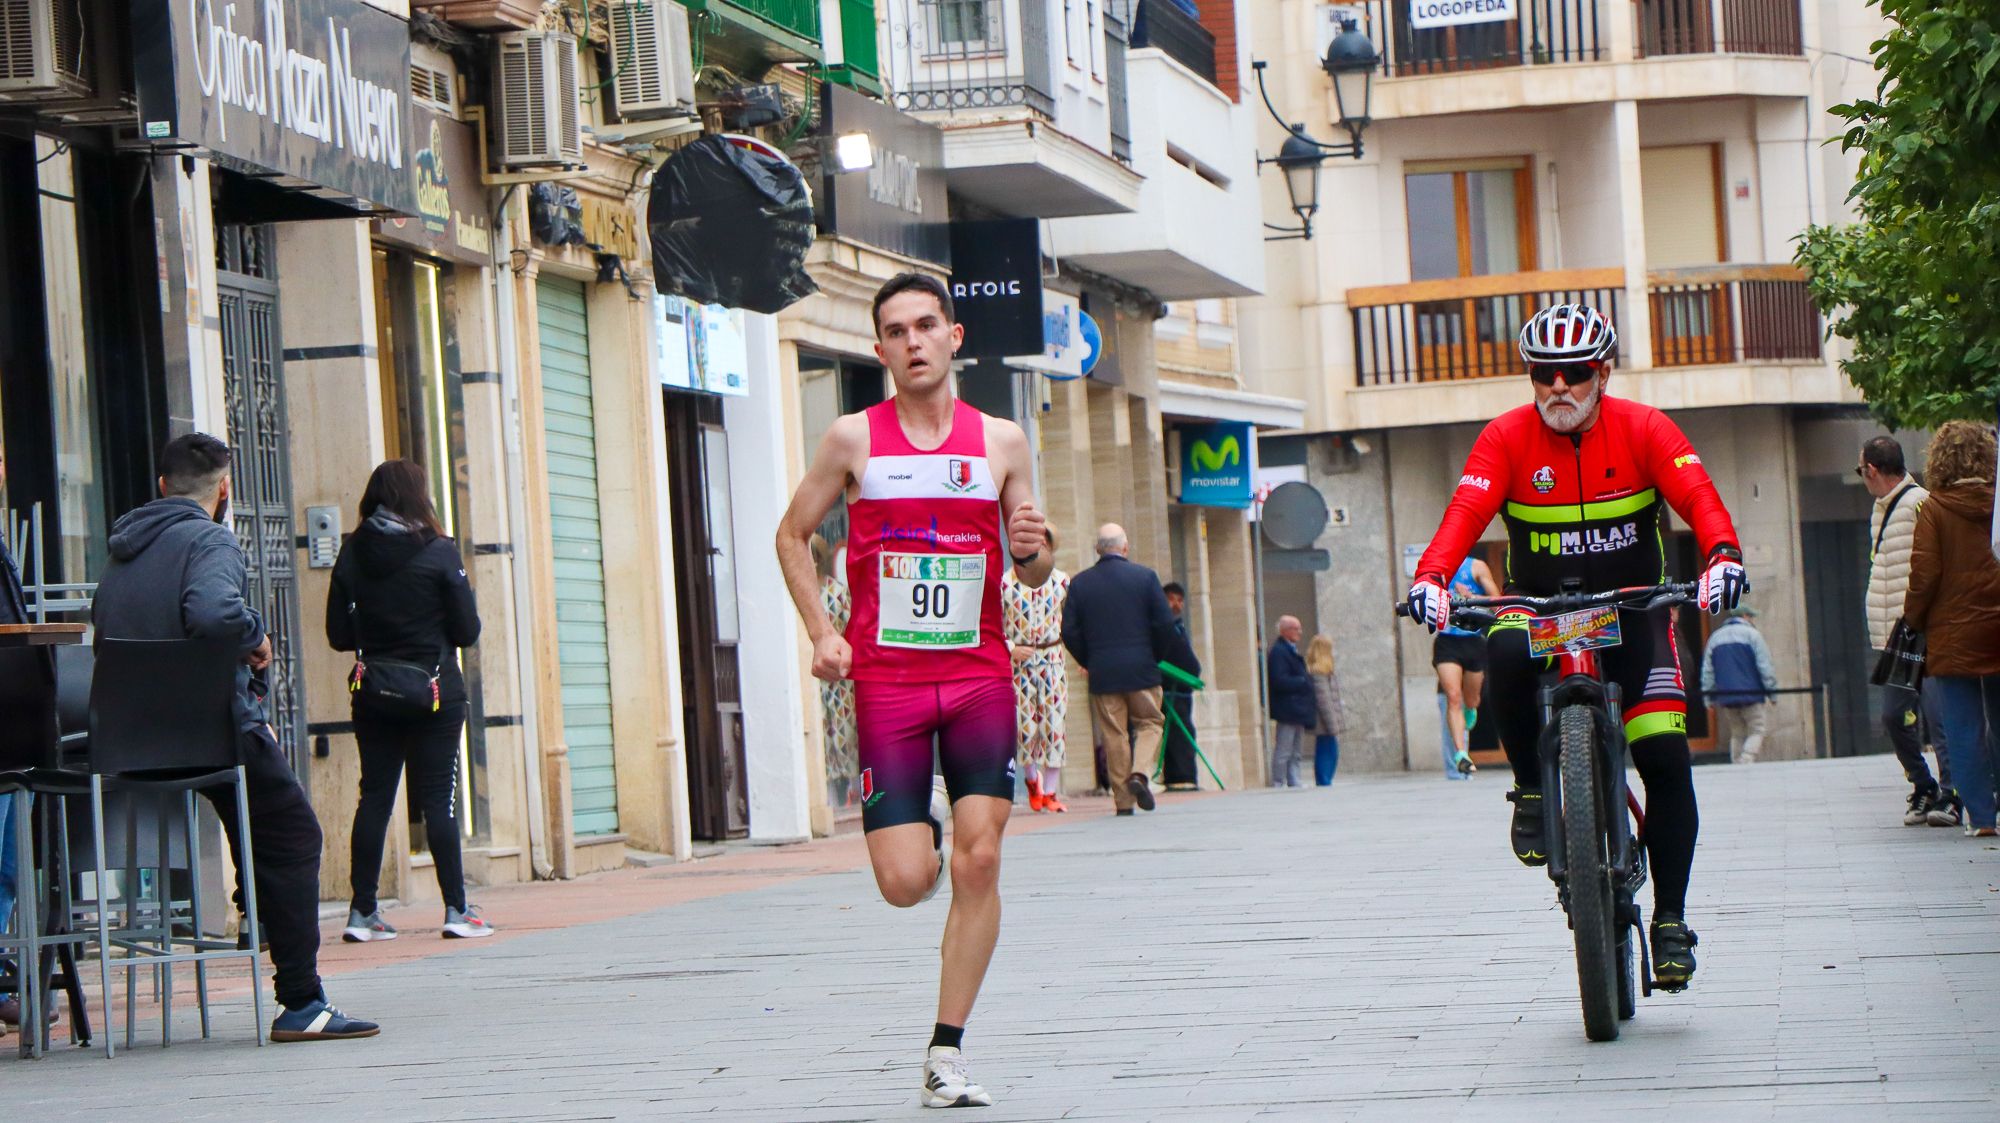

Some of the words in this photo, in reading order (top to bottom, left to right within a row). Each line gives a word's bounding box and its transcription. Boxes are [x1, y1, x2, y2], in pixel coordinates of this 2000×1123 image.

[1418, 0, 1507, 19] LOGOPEDA
[264, 0, 332, 143] Plaza
[328, 16, 402, 170] Nueva
[1189, 477, 1240, 488] movistar
[1333, 509, 1345, 522] 3
[936, 532, 982, 543] herakles
[1561, 522, 1637, 547] MILAR
[1561, 536, 1638, 555] LUCENA
[891, 557, 921, 579] 10K
[912, 583, 950, 619] 90
